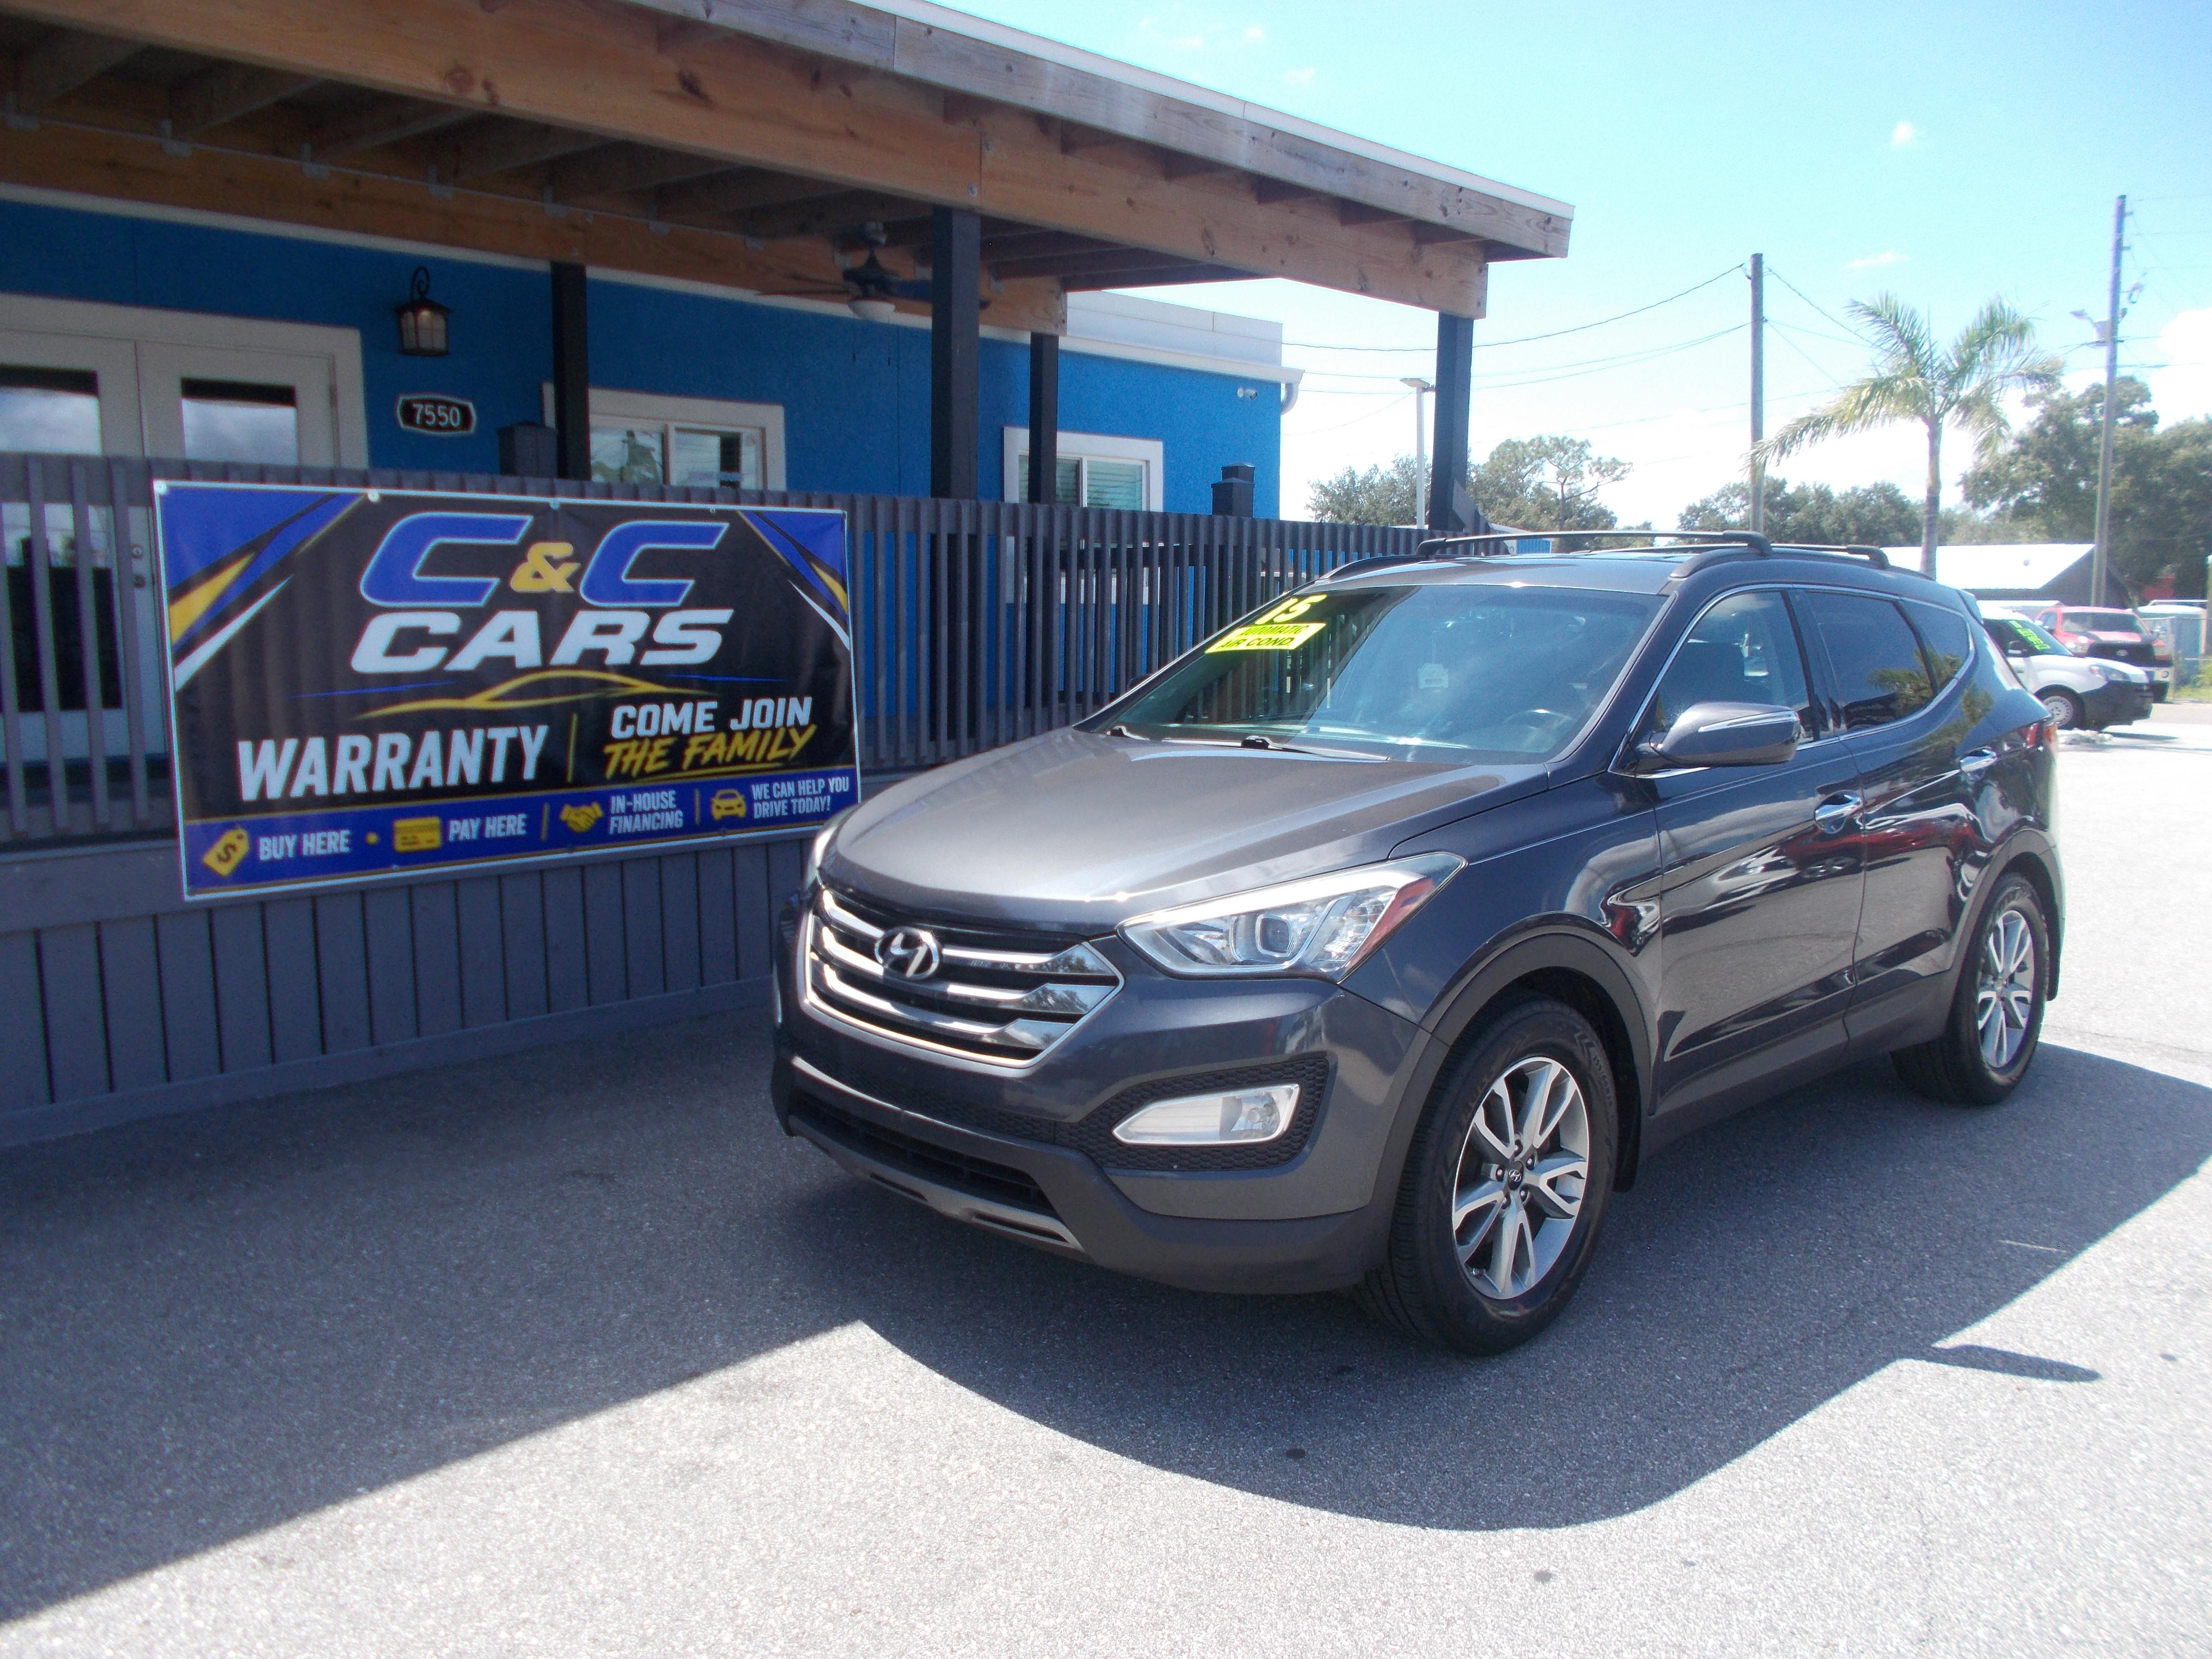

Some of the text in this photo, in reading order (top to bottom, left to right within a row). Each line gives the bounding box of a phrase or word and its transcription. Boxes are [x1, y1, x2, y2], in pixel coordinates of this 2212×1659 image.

[413, 403, 461, 427] 7550
[1254, 594, 1328, 625] 15
[350, 609, 734, 673] CARS
[1216, 638, 1247, 649] AIR
[1237, 625, 1310, 637] AUTOMATIC
[611, 697, 813, 739] COME JOIN
[238, 725, 549, 802] WARRANTY
[603, 724, 817, 780] THE FAMILY
[751, 776, 849, 800] WE CAN HELP YOU
[610, 790, 677, 814] IN-HOUSE
[754, 795, 831, 819] DRIVE TODAY!
[448, 814, 527, 842] PAY HERE
[609, 811, 684, 835] FINANCING
[258, 830, 351, 861] BUY HERE
